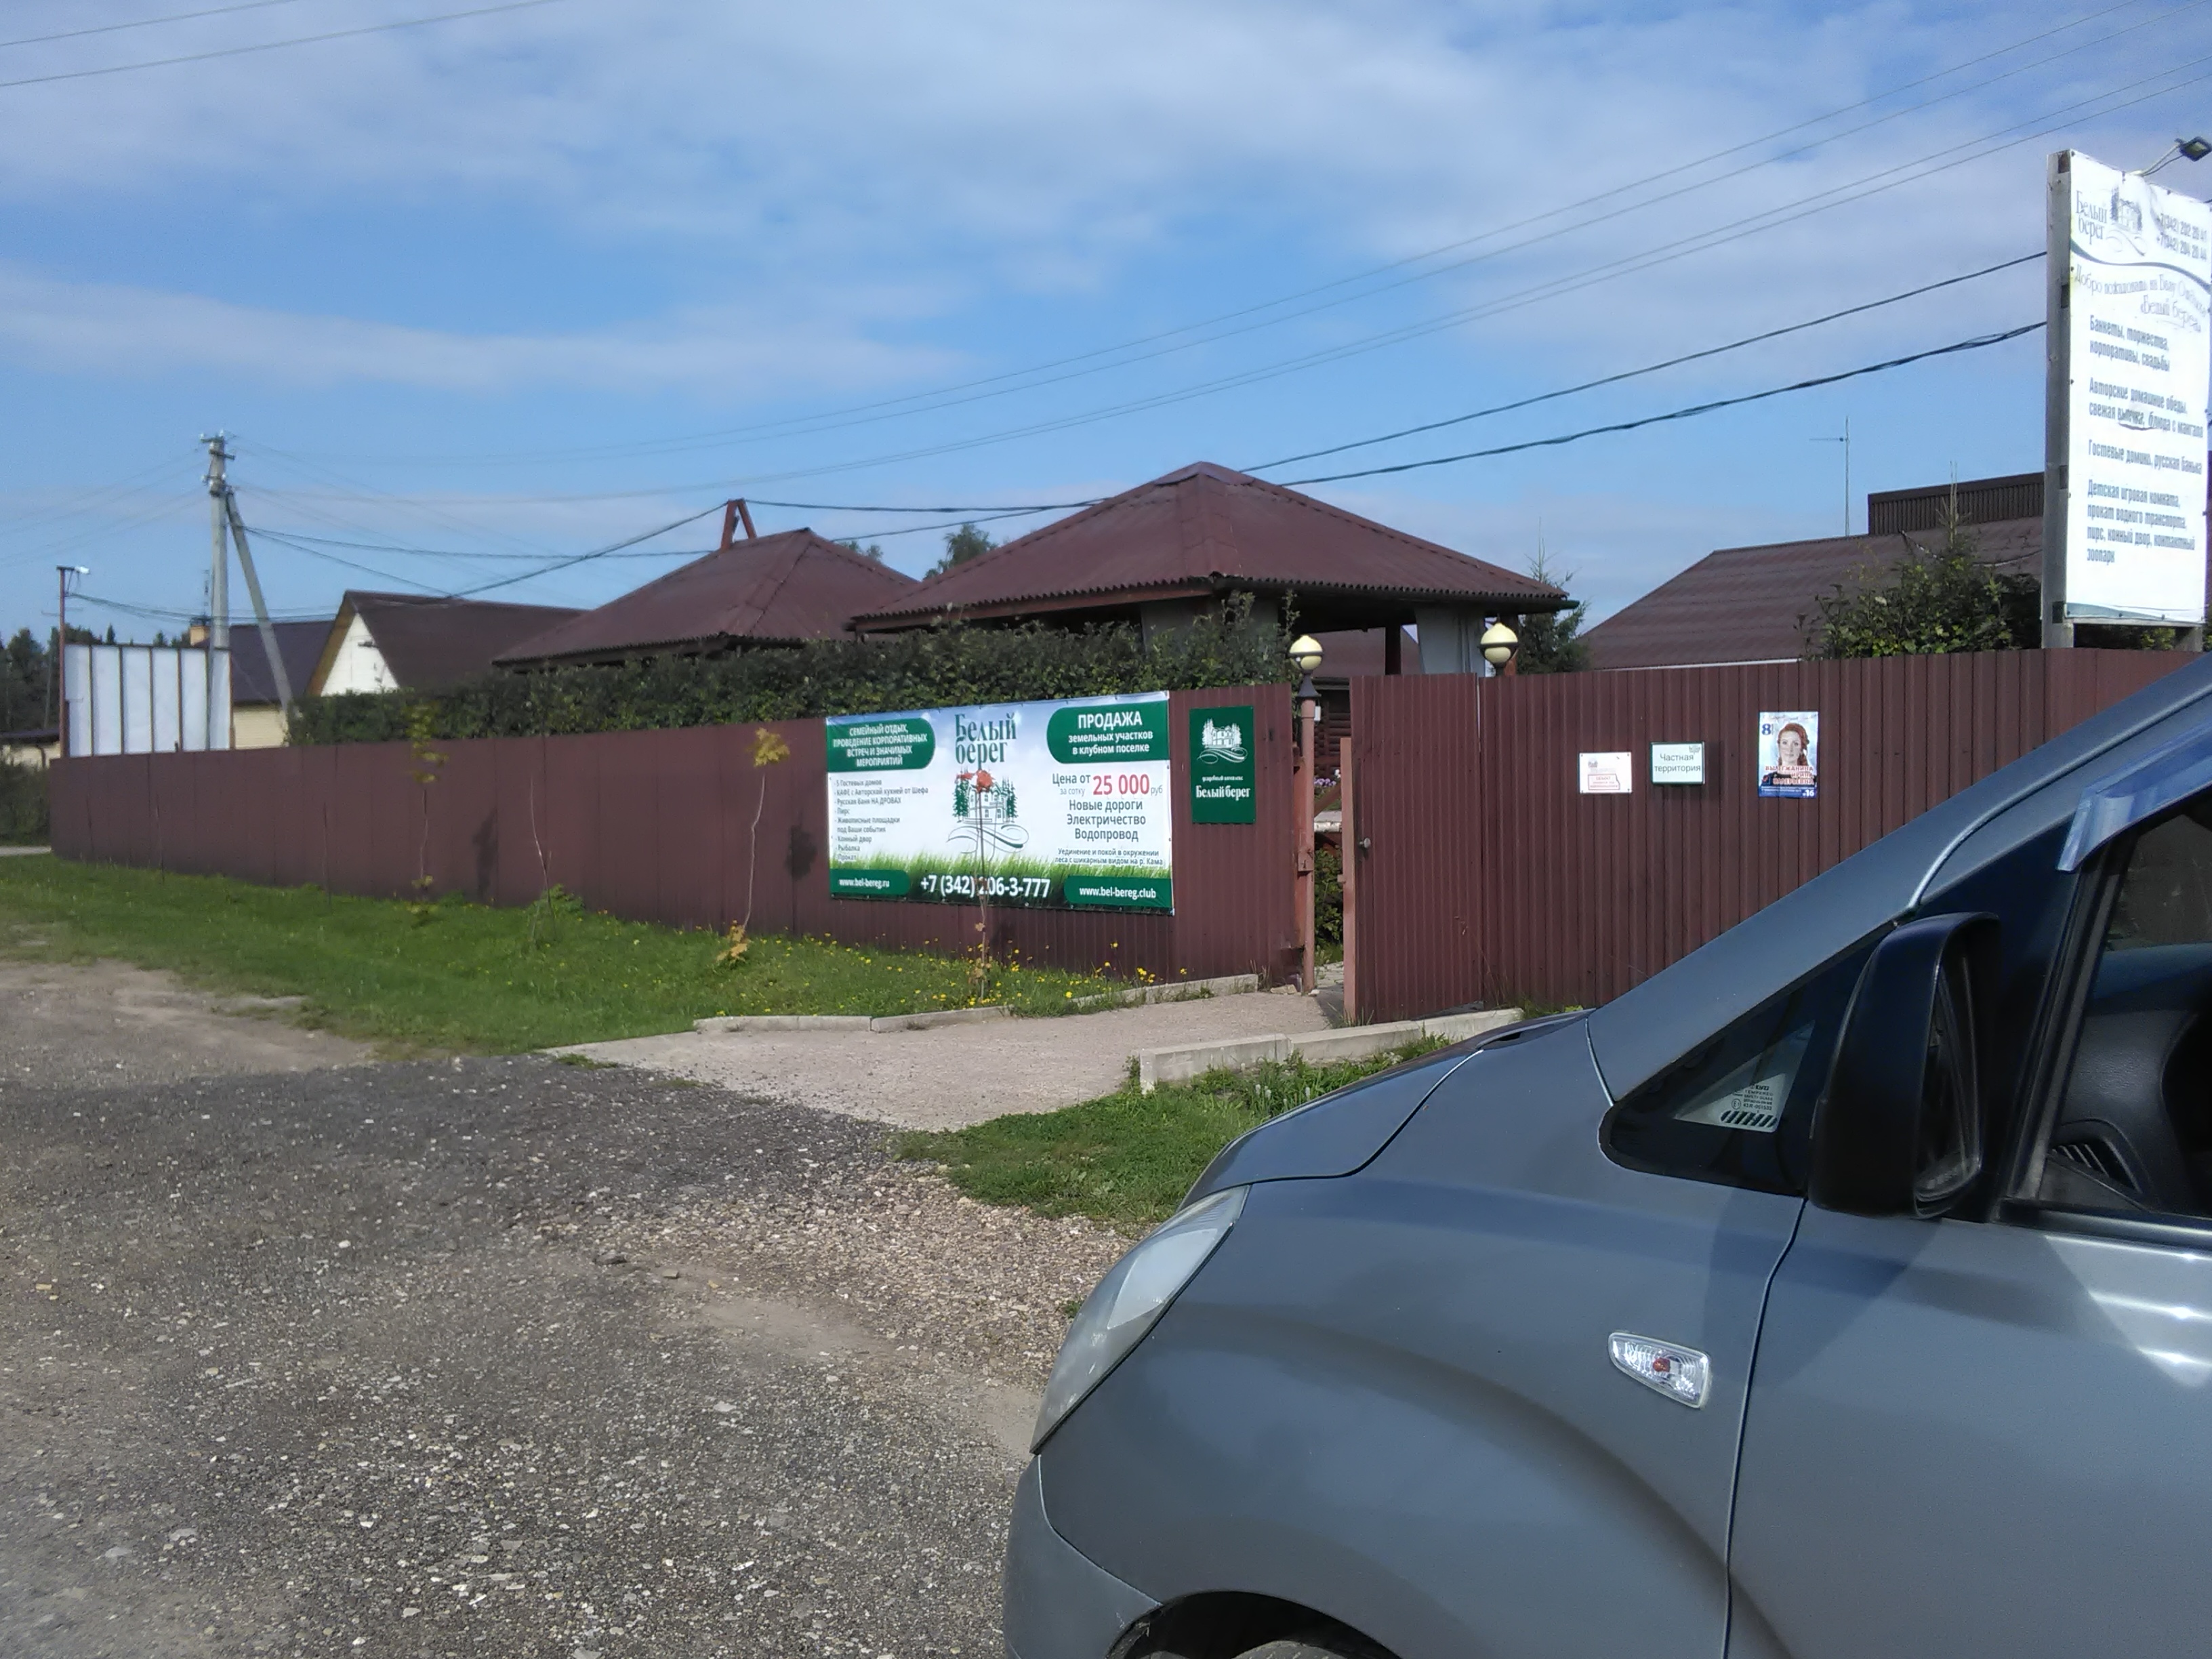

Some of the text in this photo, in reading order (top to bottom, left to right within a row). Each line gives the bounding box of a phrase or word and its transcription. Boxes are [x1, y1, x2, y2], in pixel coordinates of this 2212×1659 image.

[2089, 377, 2128, 400] Авторские
[2089, 402, 2116, 419] свежая
[2089, 439, 2125, 461] Гостевые
[2088, 479, 2119, 499] Детская
[2121, 487, 2148, 504] игровая
[2087, 504, 2114, 520] прокат
[2116, 508, 2143, 524] водного
[2108, 528, 2133, 544] конный
[2087, 548, 2115, 566] зоопарк
[954, 712, 1017, 741] Белый
[1078, 711, 1143, 731] ПРОДАЖА
[849, 724, 883, 736] СЕМЕЙНЫЙ
[1762, 723, 1771, 735] 8
[833, 734, 928, 747] ПРОВЕДЕНИЕ КОРПОРАТИВНЫХ
[1068, 731, 1153, 743] земельных участков
[847, 747, 869, 757] ВСТРЕЧ
[876, 745, 912, 756] ЗНАЧИМЫХ
[956, 737, 1008, 770] берег
[1080, 745, 1114, 756] клубном
[1116, 744, 1150, 753] поселке
[856, 756, 903, 767] МЕРОПРИЯТИЙ
[1660, 753, 1694, 761] Частная
[1654, 765, 1700, 774] территория
[1052, 773, 1164, 796] Цена от 25 000 руб
[855, 787, 882, 796] Авторской
[884, 787, 903, 796] кухней
[1068, 788, 1086, 797] сотку
[1195, 785, 1251, 801] Белый берег
[880, 797, 901, 805] ДРОВАХ
[1069, 800, 1143, 813] Новые дороги
[1067, 814, 1146, 827] Электричество
[1075, 828, 1139, 842] Водопровод
[1058, 848, 1090, 856] Уединение
[1108, 857, 1128, 865] видом
[839, 878, 890, 889] www.bel-bereg.ru
[920, 875, 1050, 898] +7 (342) 206-3-777
[1079, 886, 1156, 900] www.bel-bereg.club
